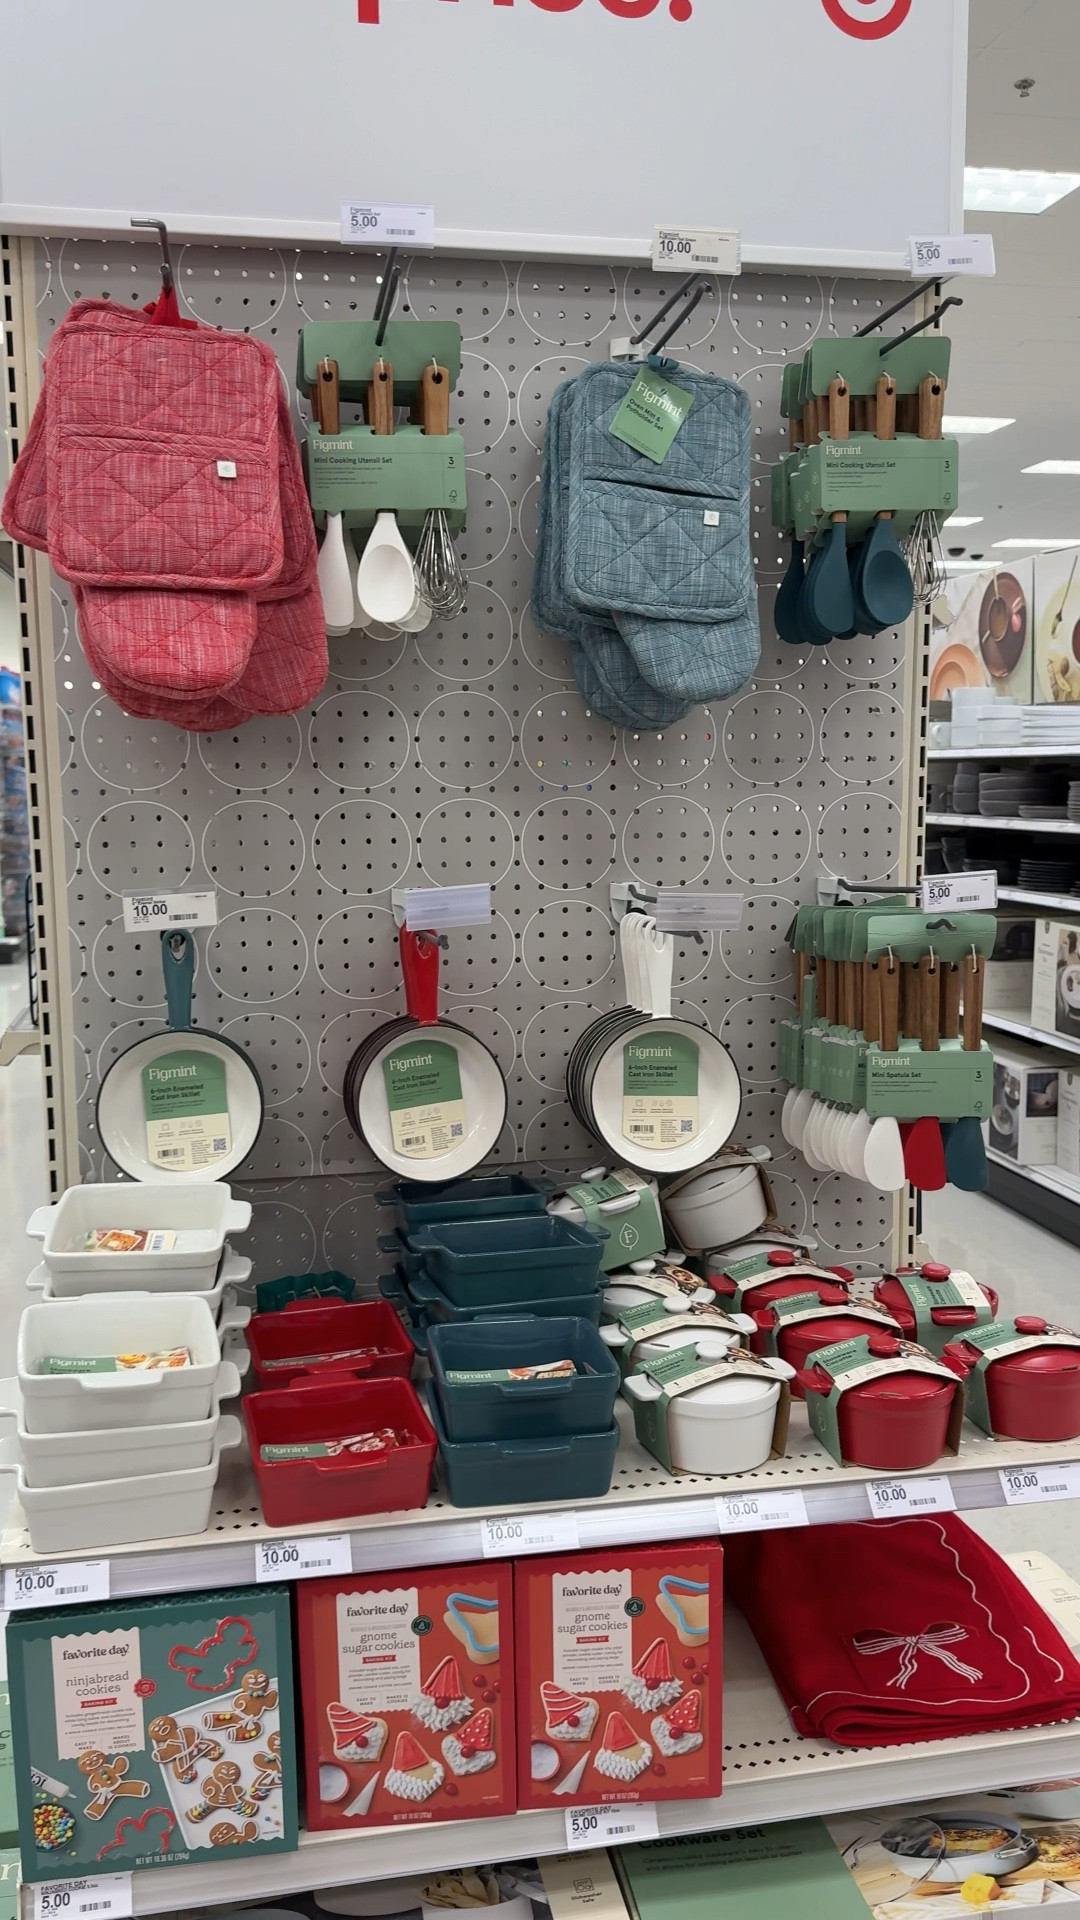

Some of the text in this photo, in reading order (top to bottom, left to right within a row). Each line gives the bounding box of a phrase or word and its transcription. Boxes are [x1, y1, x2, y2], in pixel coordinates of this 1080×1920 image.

[351, 216, 377, 227] 5.00
[660, 240, 691, 253] 10.00
[917, 248, 940, 260] 5.00
[636, 381, 683, 418] Figmint
[629, 398, 644, 411] Oven
[644, 407, 656, 418] Mitt
[626, 404, 664, 432] Potholder Set
[312, 440, 354, 452] Figmint
[826, 446, 862, 458] Figmint
[329, 457, 357, 466] Cooking
[448, 456, 454, 465] 3
[840, 462, 864, 470] Cooking
[944, 460, 950, 468] 3
[929, 888, 950, 898] 5.00
[133, 904, 168, 916] 10.00
[628, 1045, 672, 1059] Figmint
[389, 1054, 432, 1072] Figmint
[872, 1056, 911, 1068] Figmint
[148, 1064, 197, 1082] Figmint
[976, 1070, 982, 1079] 3
[618, 1301, 656, 1316] Figmint
[963, 1323, 1004, 1338] Figmint
[815, 1340, 857, 1358] Figmint
[50, 1358, 97, 1366] Figmint
[643, 1350, 684, 1368] Figmint
[450, 1372, 492, 1380] Figmint
[264, 1446, 309, 1454] Figmint
[1007, 1474, 1038, 1488] 10.00
[874, 1488, 907, 1502] 10.00
[726, 1502, 758, 1516] 10.00
[488, 1525, 522, 1540] 10.00
[263, 1548, 299, 1564] 10.00
[16, 1574, 54, 1590] 10.00
[562, 1584, 622, 1597] favorite day
[346, 1603, 408, 1617] favorite day
[574, 1612, 610, 1624] gnome
[557, 1620, 628, 1634] sugar cookies
[360, 1632, 397, 1644] gnome
[62, 1644, 130, 1660] favorite day
[342, 1640, 416, 1655] sugar cookies
[66, 1670, 130, 1688] ninjabread
[75, 1684, 122, 1696] cookies
[572, 1816, 598, 1831] 5.00
[638, 1828, 766, 1849] Cookware Set
[40, 1882, 74, 1892] FAVORITE
[42, 1892, 70, 1910] 5.00
[571, 1892, 602, 1900] Dishwasher
